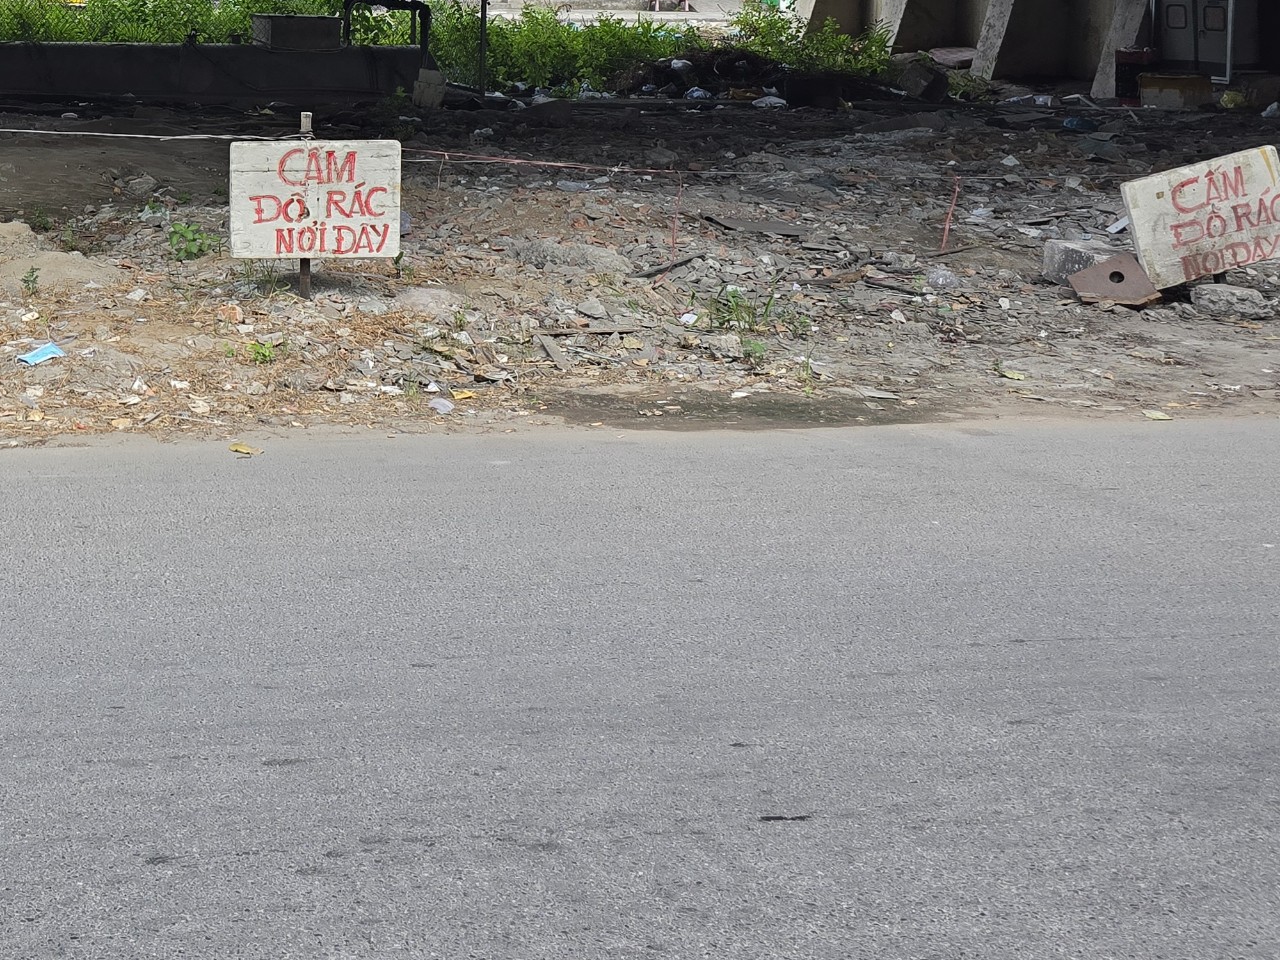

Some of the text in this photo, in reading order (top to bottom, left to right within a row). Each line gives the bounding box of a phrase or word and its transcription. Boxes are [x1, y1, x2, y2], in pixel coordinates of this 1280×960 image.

[325, 181, 388, 219] RÁC
[1171, 164, 1248, 214] CẤM
[332, 223, 390, 255] ĐÂY
